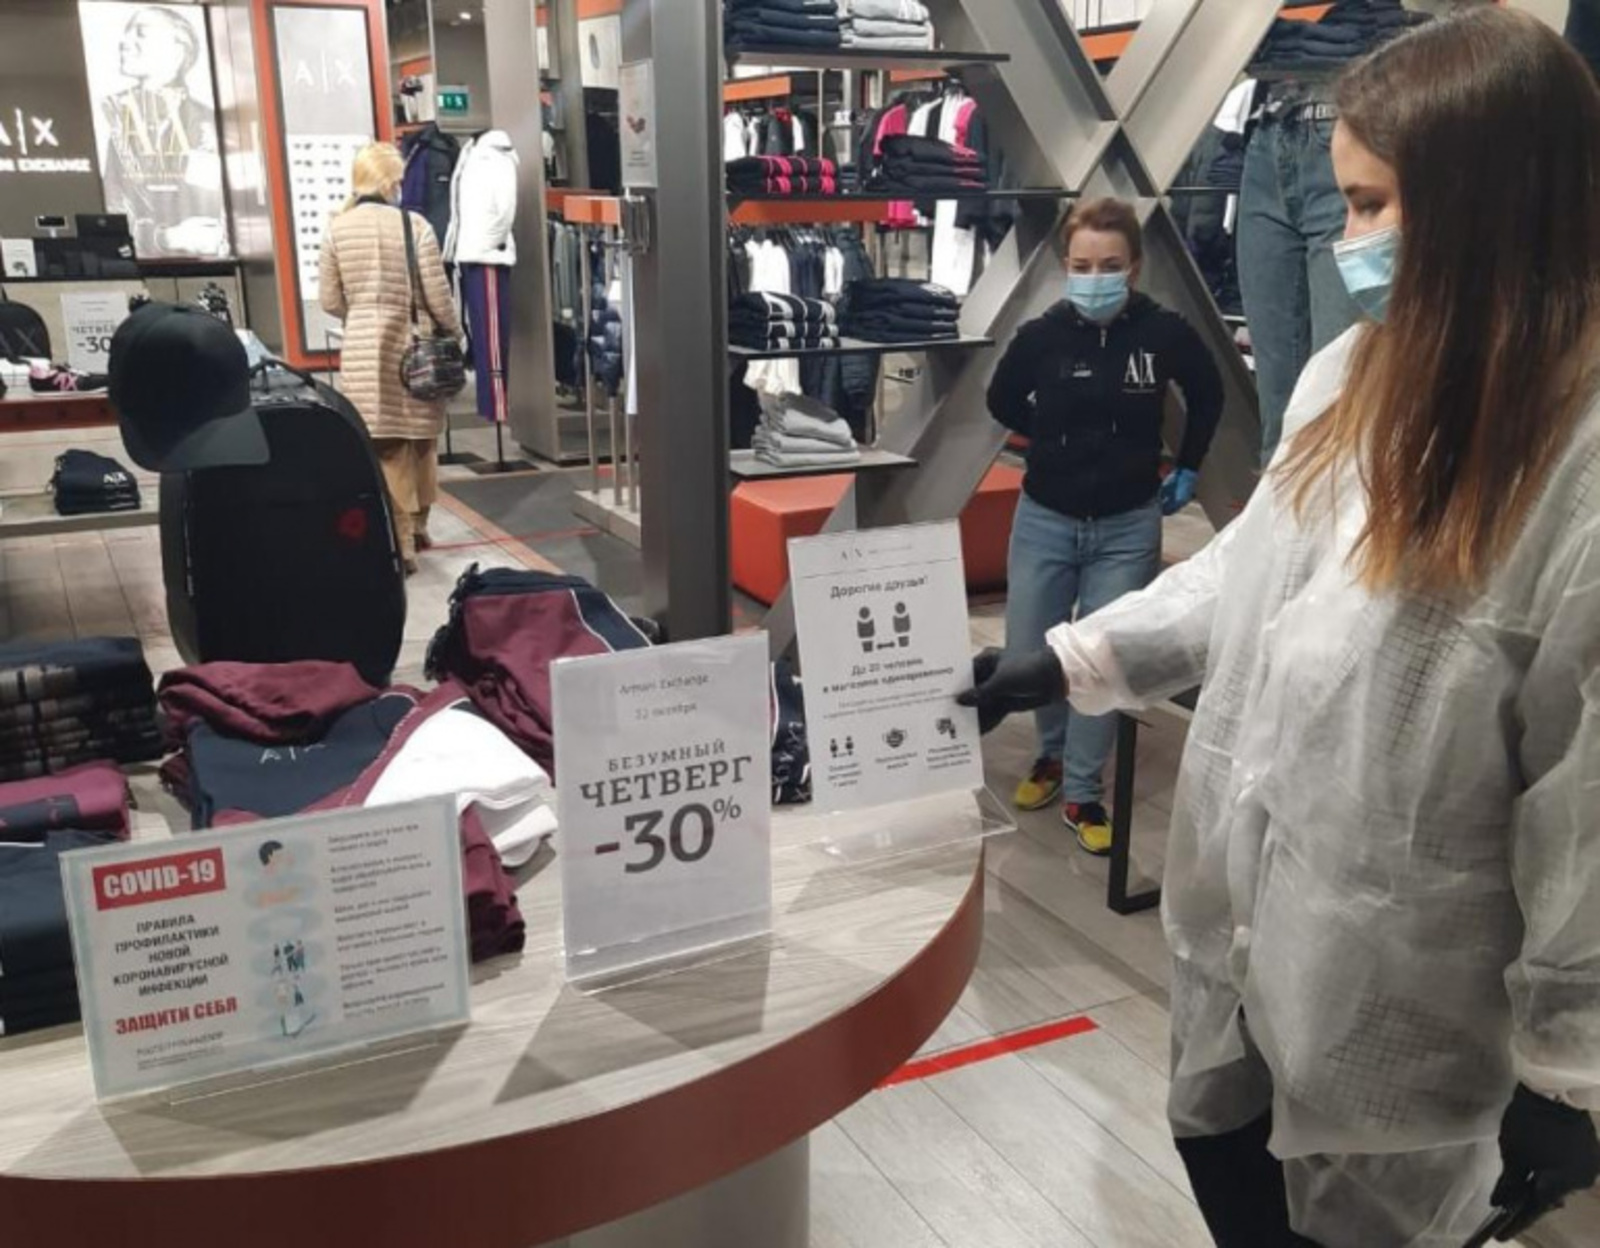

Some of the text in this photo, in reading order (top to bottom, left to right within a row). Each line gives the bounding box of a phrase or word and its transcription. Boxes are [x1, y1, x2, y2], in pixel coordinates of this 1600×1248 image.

[830, 581, 882, 600] Дорогие
[660, 674, 710, 691] Exchange
[608, 738, 726, 773] БЕЗУМНЫЙ
[580, 756, 752, 808] ЧЕТВЕРГ
[102, 858, 218, 900] COVID-19
[136, 912, 195, 934] ПРАВИЛА
[115, 925, 219, 954] ПРОФИЛАКТИКИ
[148, 945, 191, 964] НОВОЙ
[113, 953, 229, 987] КОРОНАВИРУСНОЙ
[138, 975, 208, 997] ИНФЕКЦИИ
[115, 996, 238, 1035] ЗАЩИТИ СЕБЯ
